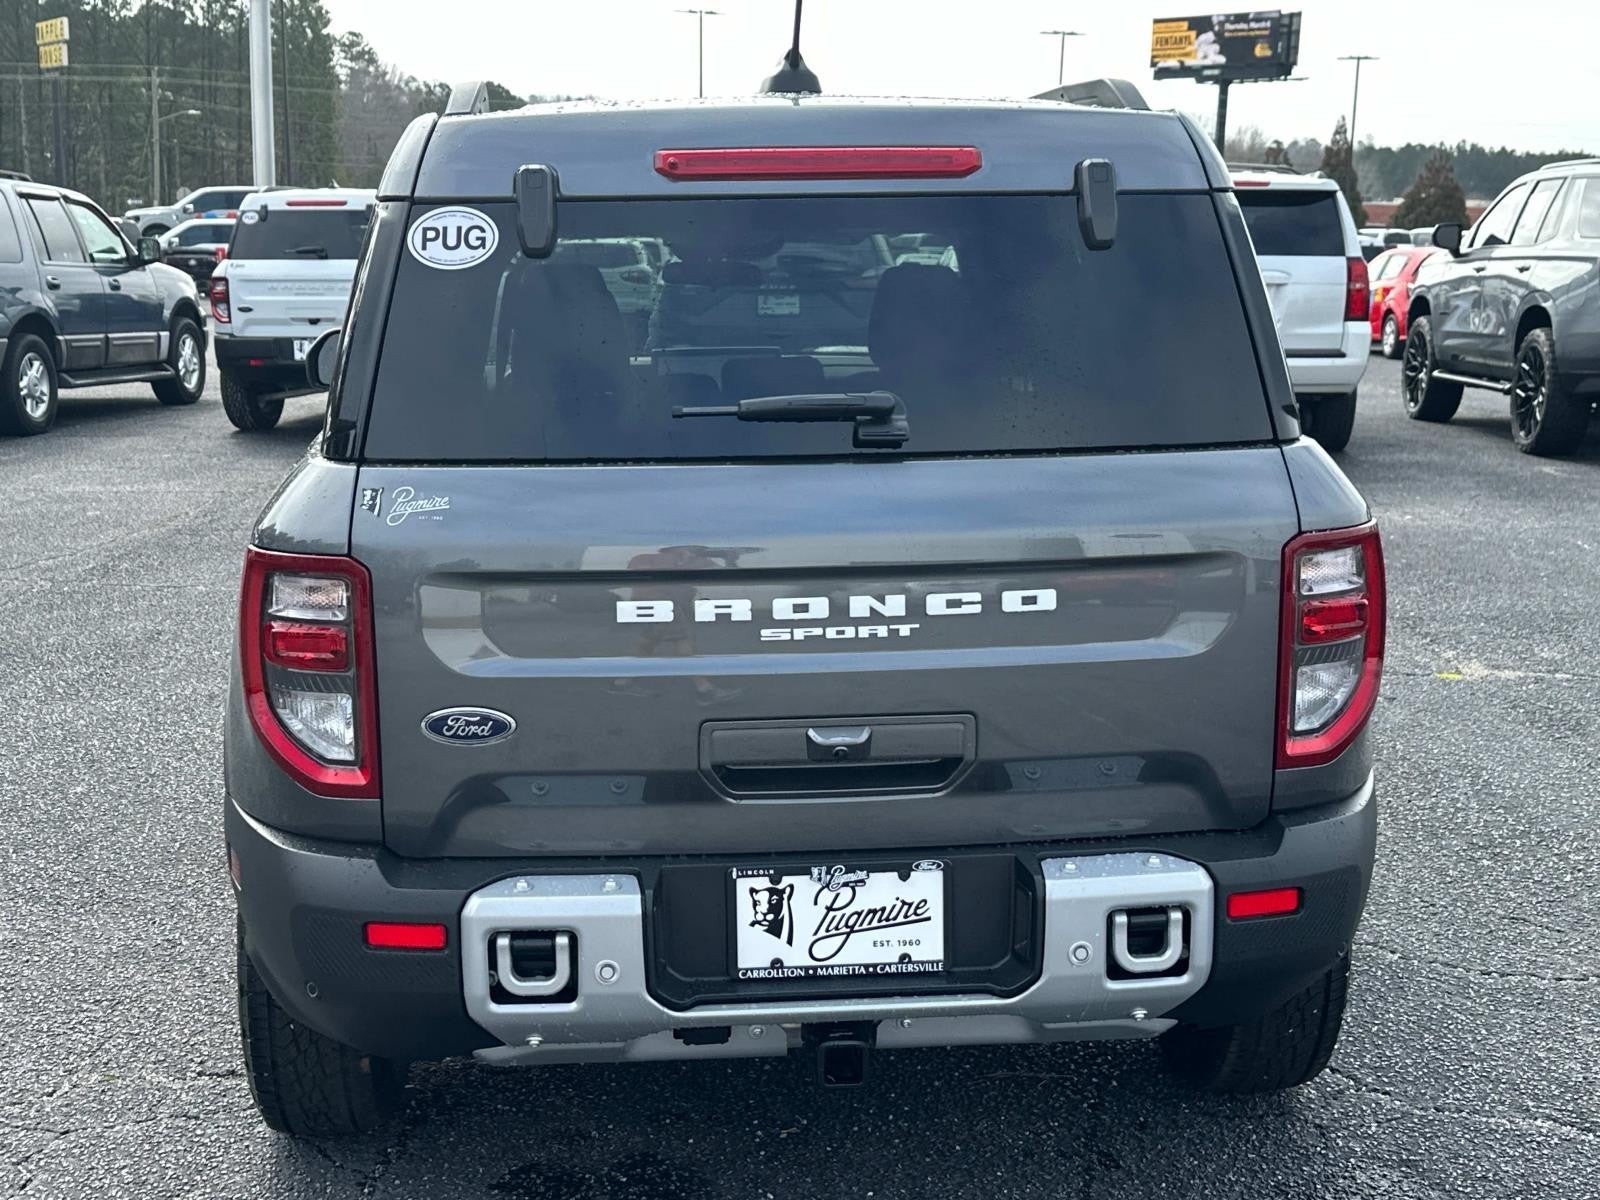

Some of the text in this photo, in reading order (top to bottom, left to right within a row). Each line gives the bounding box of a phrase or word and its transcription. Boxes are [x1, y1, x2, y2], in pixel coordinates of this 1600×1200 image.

[1155, 34, 1192, 48] FENTANYL
[421, 225, 487, 251] PUG
[387, 486, 450, 526] Pugmire
[616, 588, 1057, 623] BRONCO
[760, 623, 920, 641] SPORT
[443, 715, 494, 736] Ford
[808, 885, 932, 962] Pugmire
[873, 938, 921, 948] EST. 1960
[738, 962, 944, 979] CARROLLTON MARIETTA CARTERSVILLE
